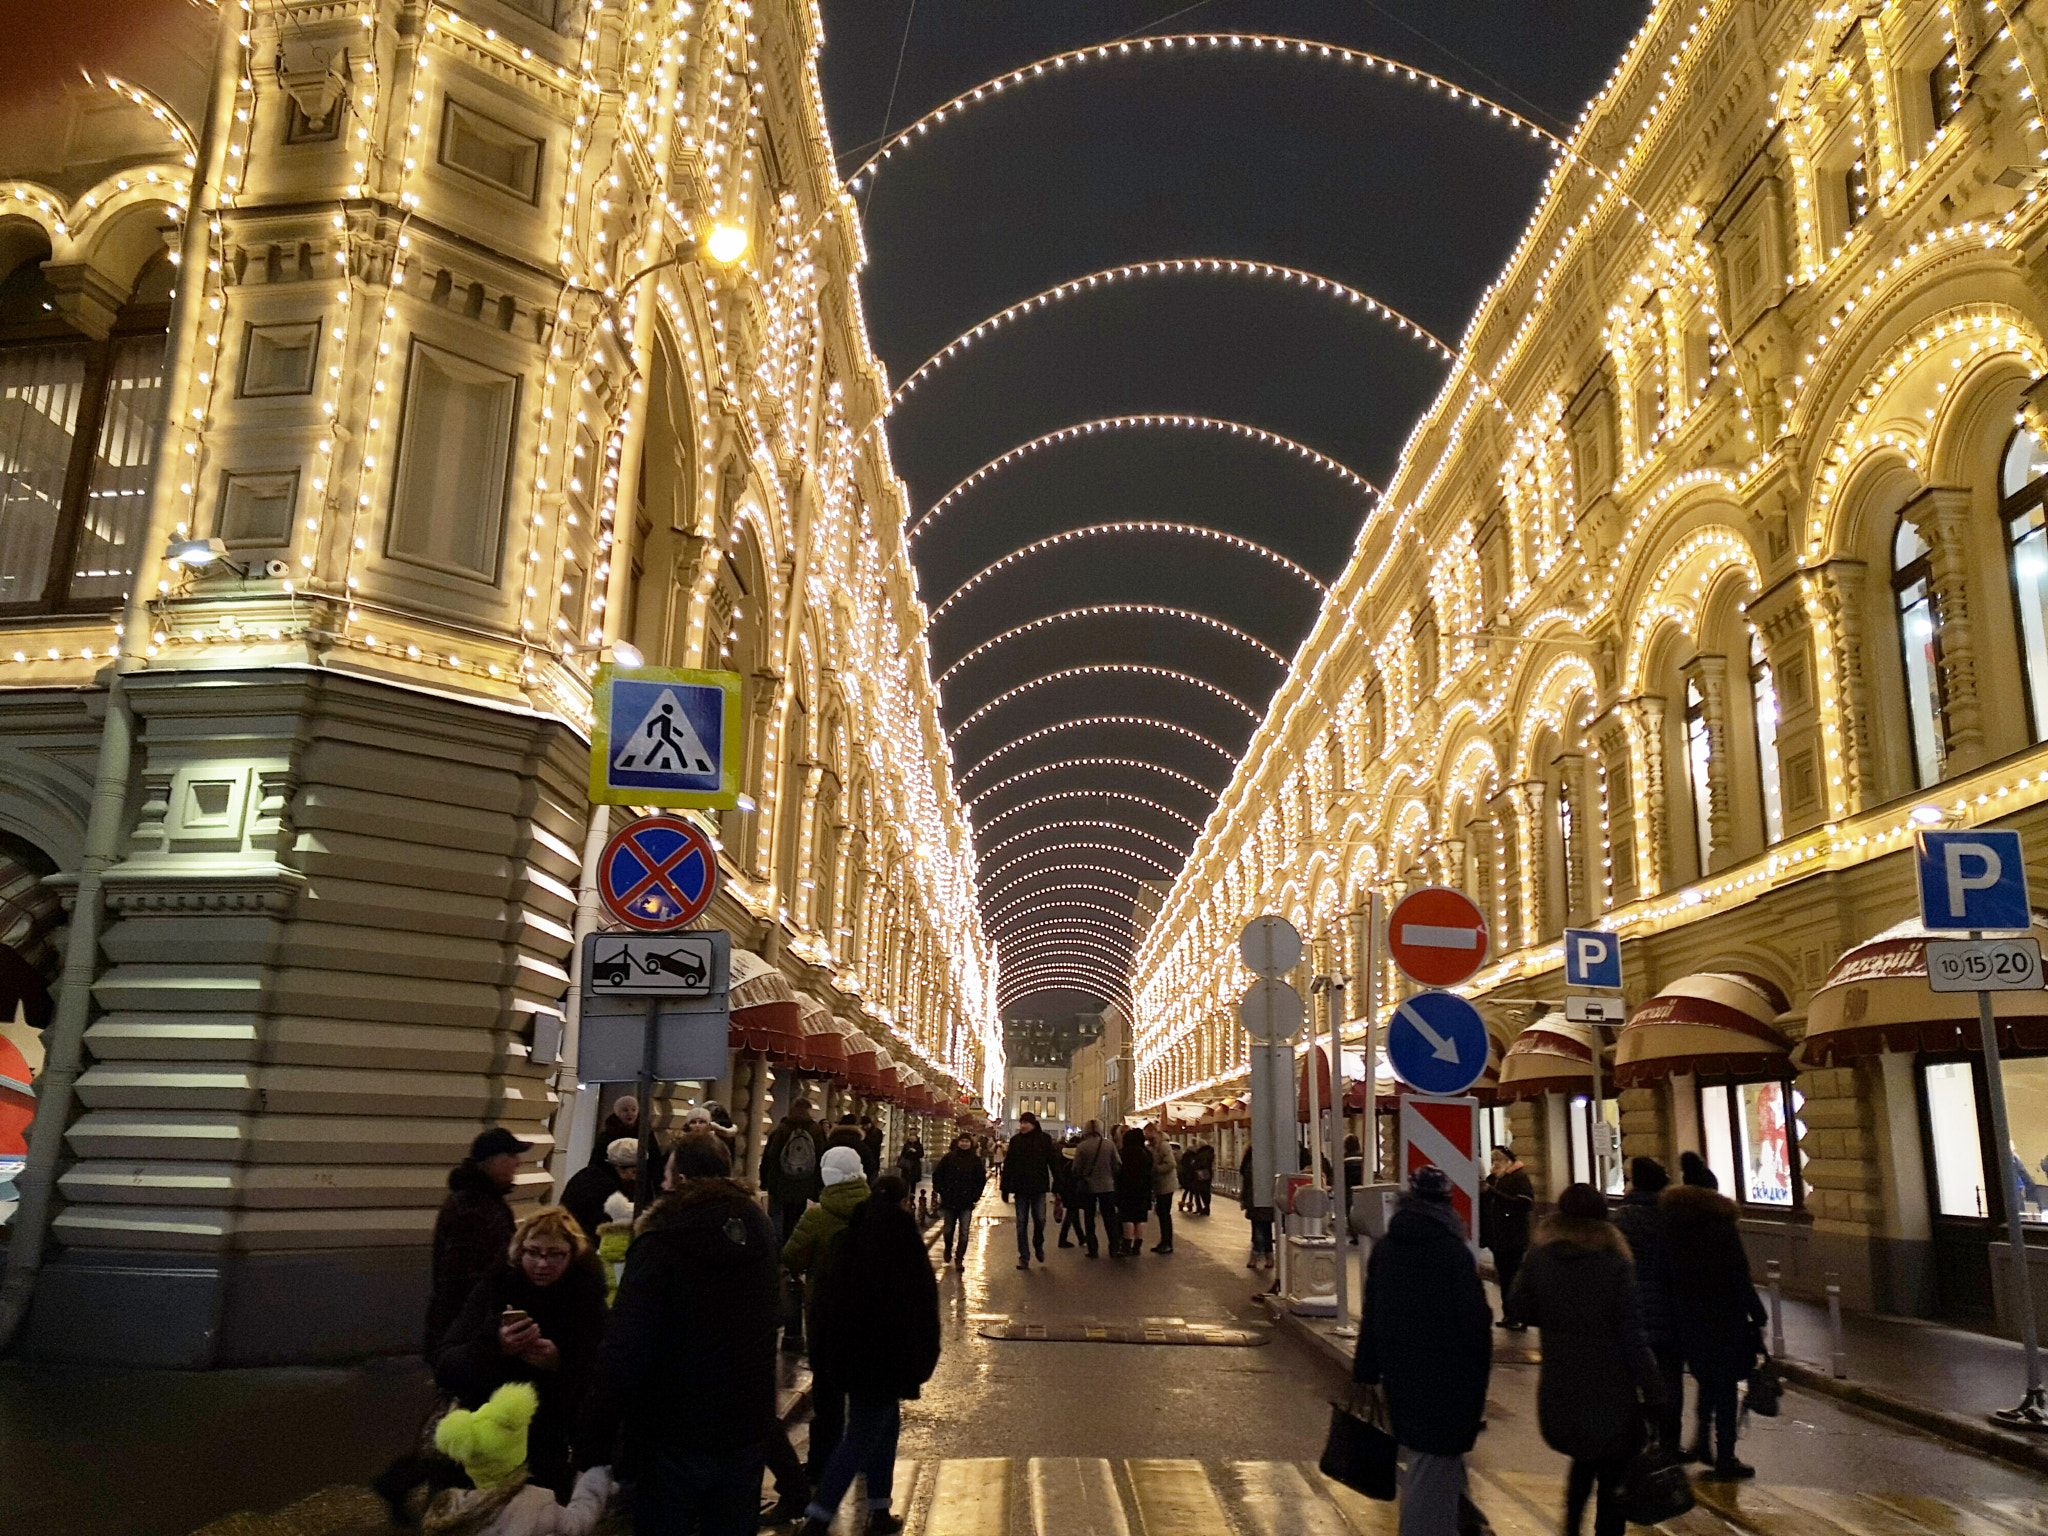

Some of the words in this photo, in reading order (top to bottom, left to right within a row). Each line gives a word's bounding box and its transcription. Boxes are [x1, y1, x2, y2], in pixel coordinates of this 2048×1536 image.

[1944, 843, 2002, 917] P
[1578, 938, 1607, 978] P
[1941, 960, 1959, 973] 10
[1965, 956, 1986, 973] 15
[1994, 952, 2028, 974] 20
